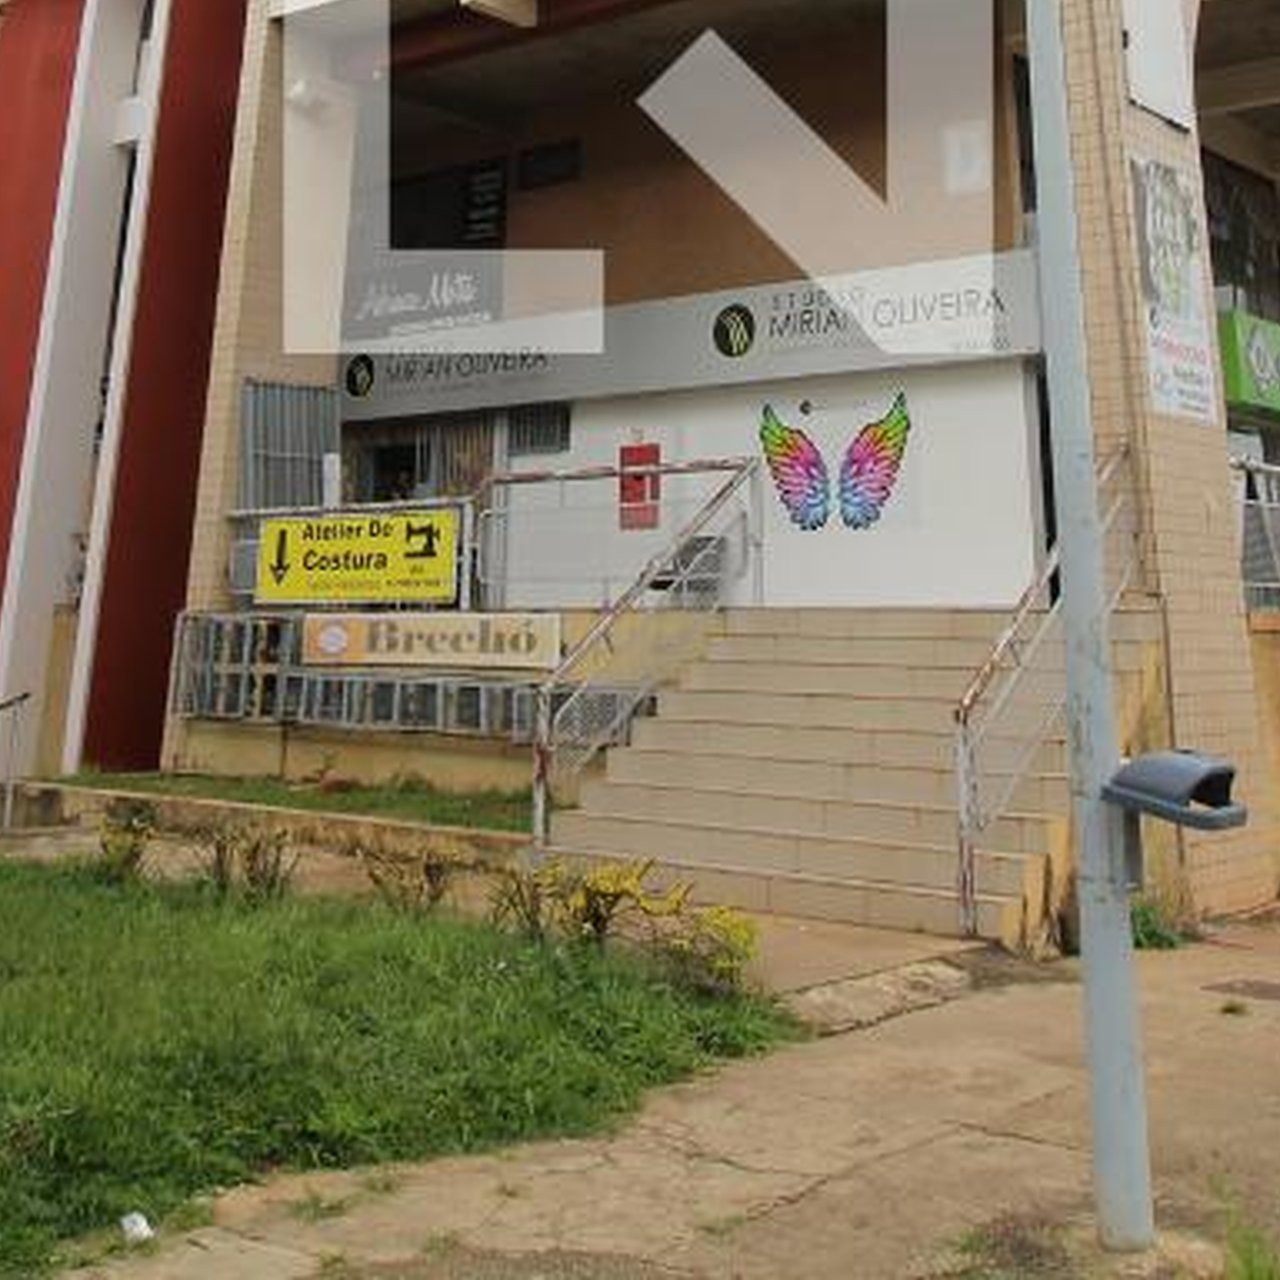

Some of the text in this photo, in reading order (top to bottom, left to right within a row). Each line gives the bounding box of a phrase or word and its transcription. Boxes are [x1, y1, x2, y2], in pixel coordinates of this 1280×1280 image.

[872, 287, 1005, 328] OLIVEIRA
[302, 522, 364, 541] Atelier
[302, 549, 388, 572] Costura
[368, 619, 538, 655] Brechó
